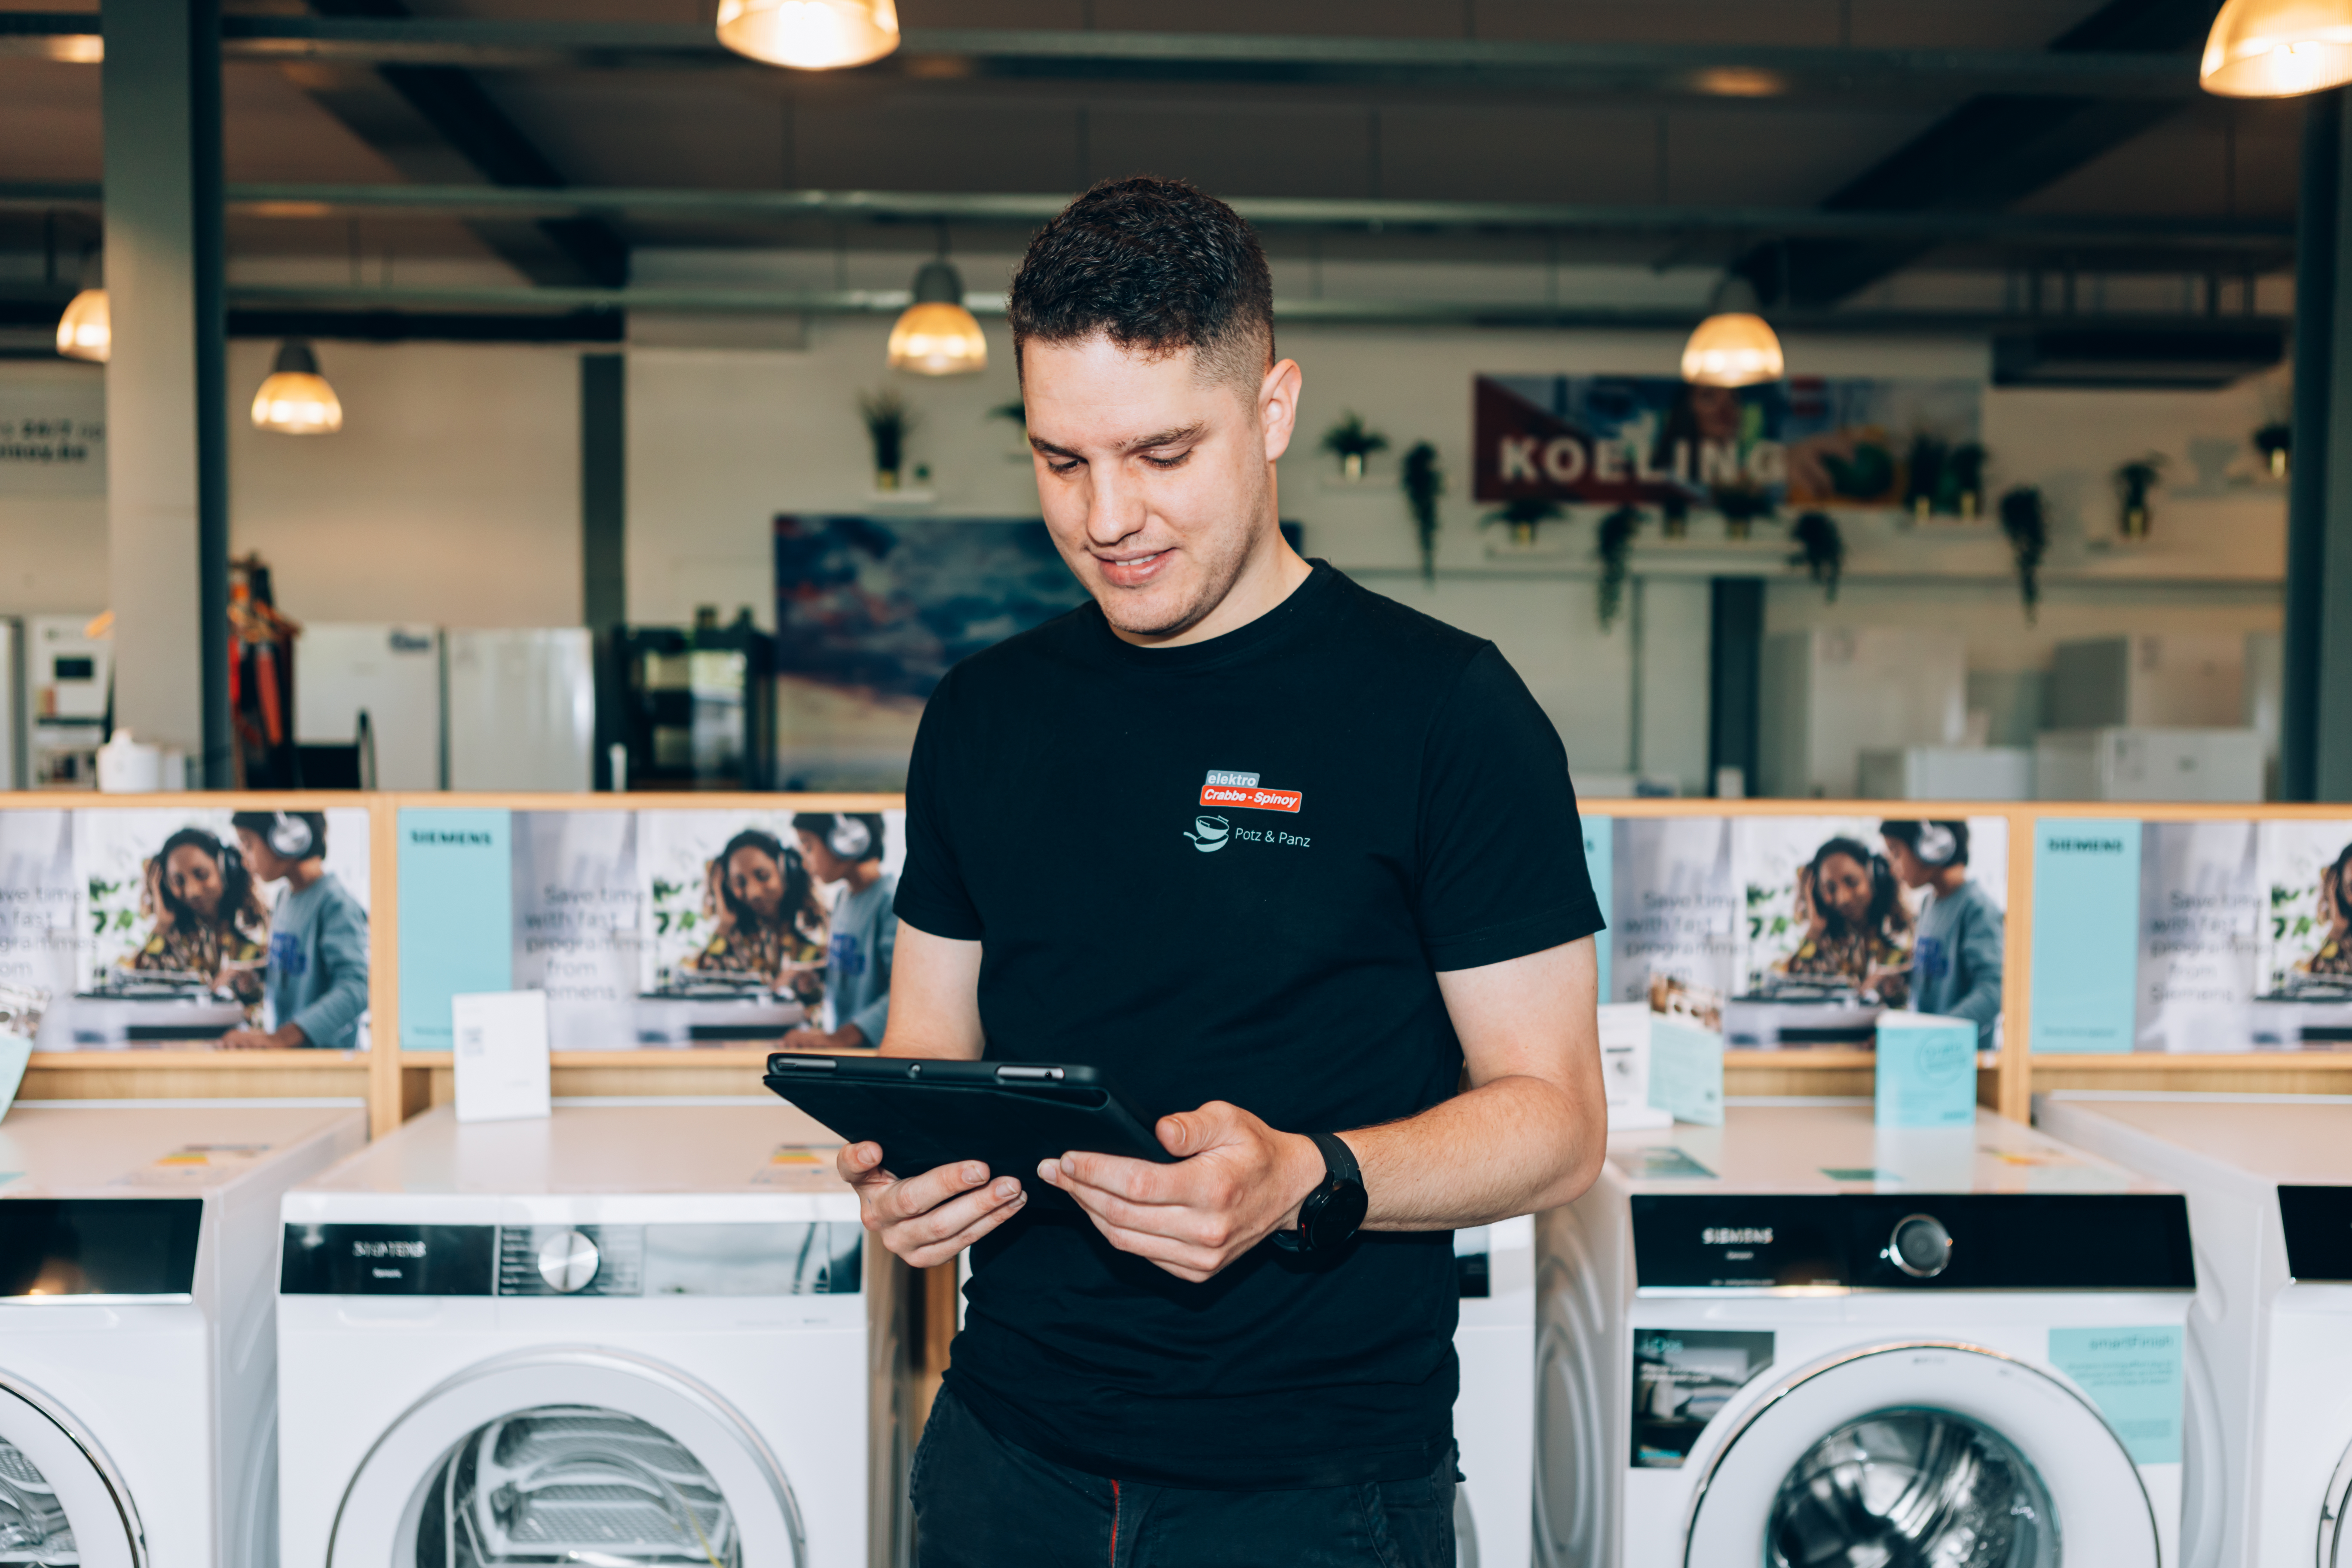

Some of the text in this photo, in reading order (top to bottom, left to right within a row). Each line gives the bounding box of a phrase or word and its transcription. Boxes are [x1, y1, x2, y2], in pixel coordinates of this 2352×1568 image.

[1500, 437, 1787, 483] KOELING
[1208, 773, 1256, 787] elektro
[410, 830, 492, 846] SIEMENS
[1235, 827, 1311, 847] Potz & Panz
[2047, 837, 2124, 854] SIEMENS
[1701, 1227, 1774, 1245] SIEMENS
